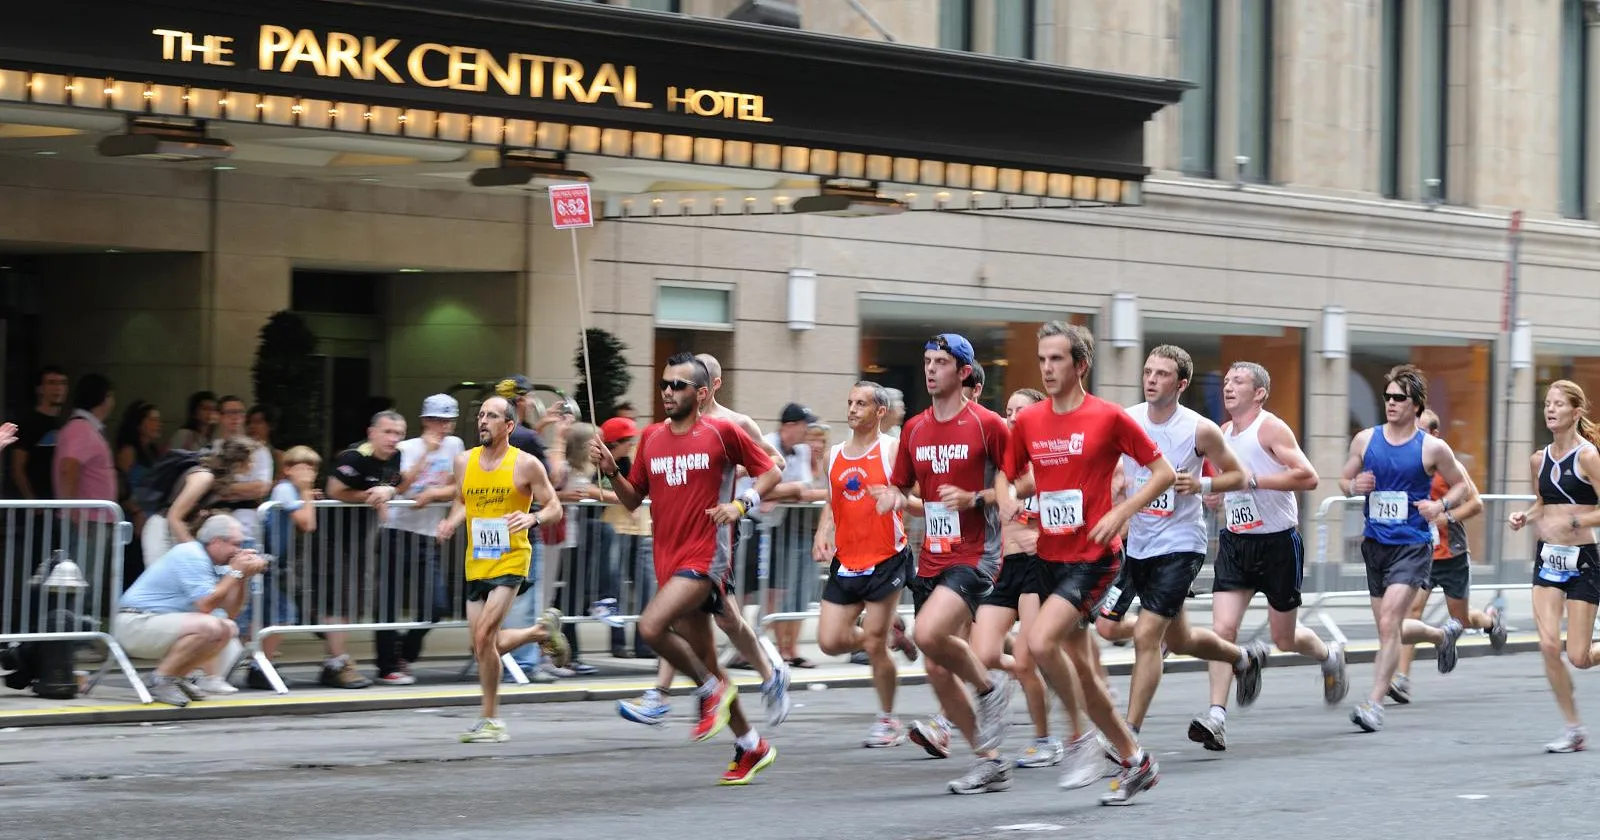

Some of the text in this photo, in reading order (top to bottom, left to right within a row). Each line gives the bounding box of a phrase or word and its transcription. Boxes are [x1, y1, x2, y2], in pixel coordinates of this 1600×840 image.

[152, 24, 774, 123] THE PARK CENTRAL HOTEL
[916, 444, 969, 462] NIKE PACER
[651, 453, 710, 475] NIKE PACER
[1047, 505, 1076, 525] 1923
[1231, 506, 1254, 525] 1963
[1378, 502, 1398, 517] 749
[929, 516, 952, 535] 1975
[480, 530, 500, 546] 934
[1549, 554, 1568, 570] 991
